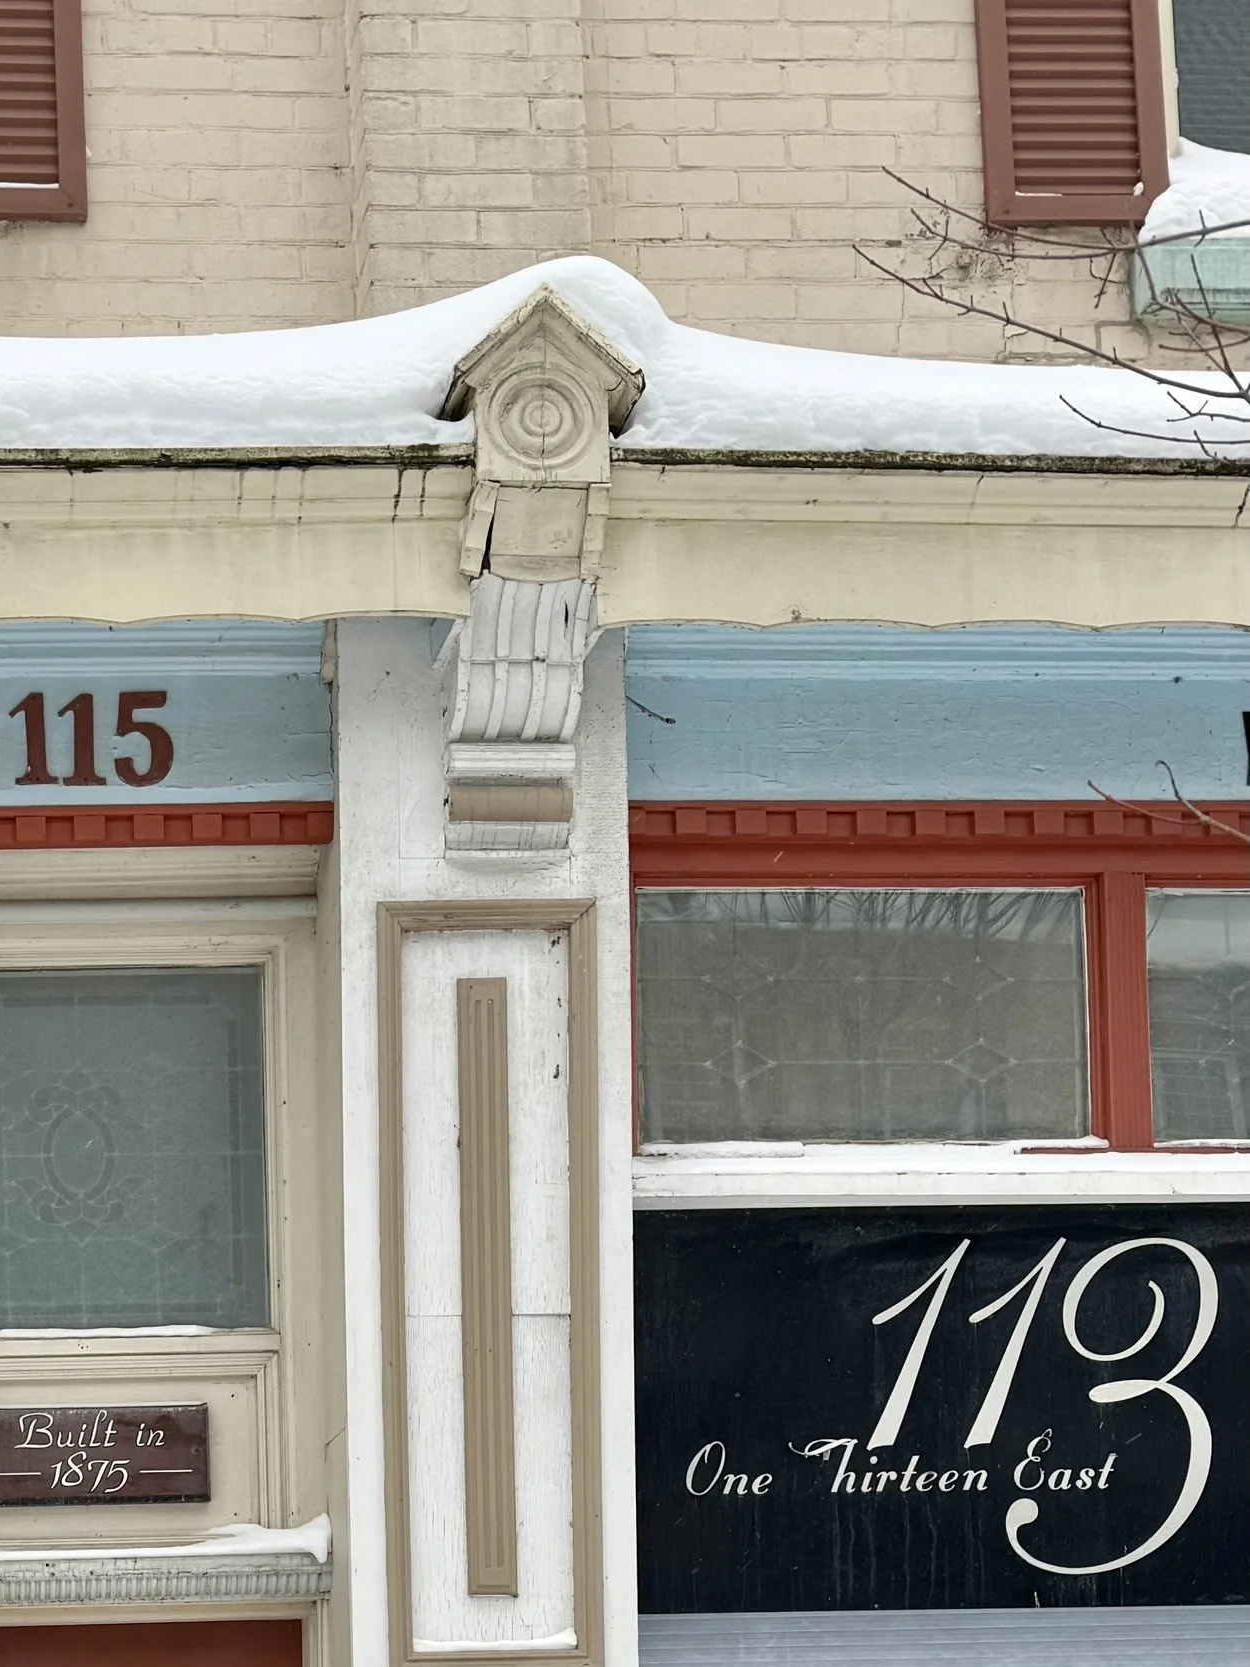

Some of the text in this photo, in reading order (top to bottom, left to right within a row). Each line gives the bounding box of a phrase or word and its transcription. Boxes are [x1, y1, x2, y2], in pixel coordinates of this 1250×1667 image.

[8, 690, 174, 787] 115
[14, 1409, 166, 1449] Built in
[867, 1236, 1219, 1575] 113
[50, 1451, 130, 1493] 1875
[684, 1428, 1118, 1496] One Thirteen East
